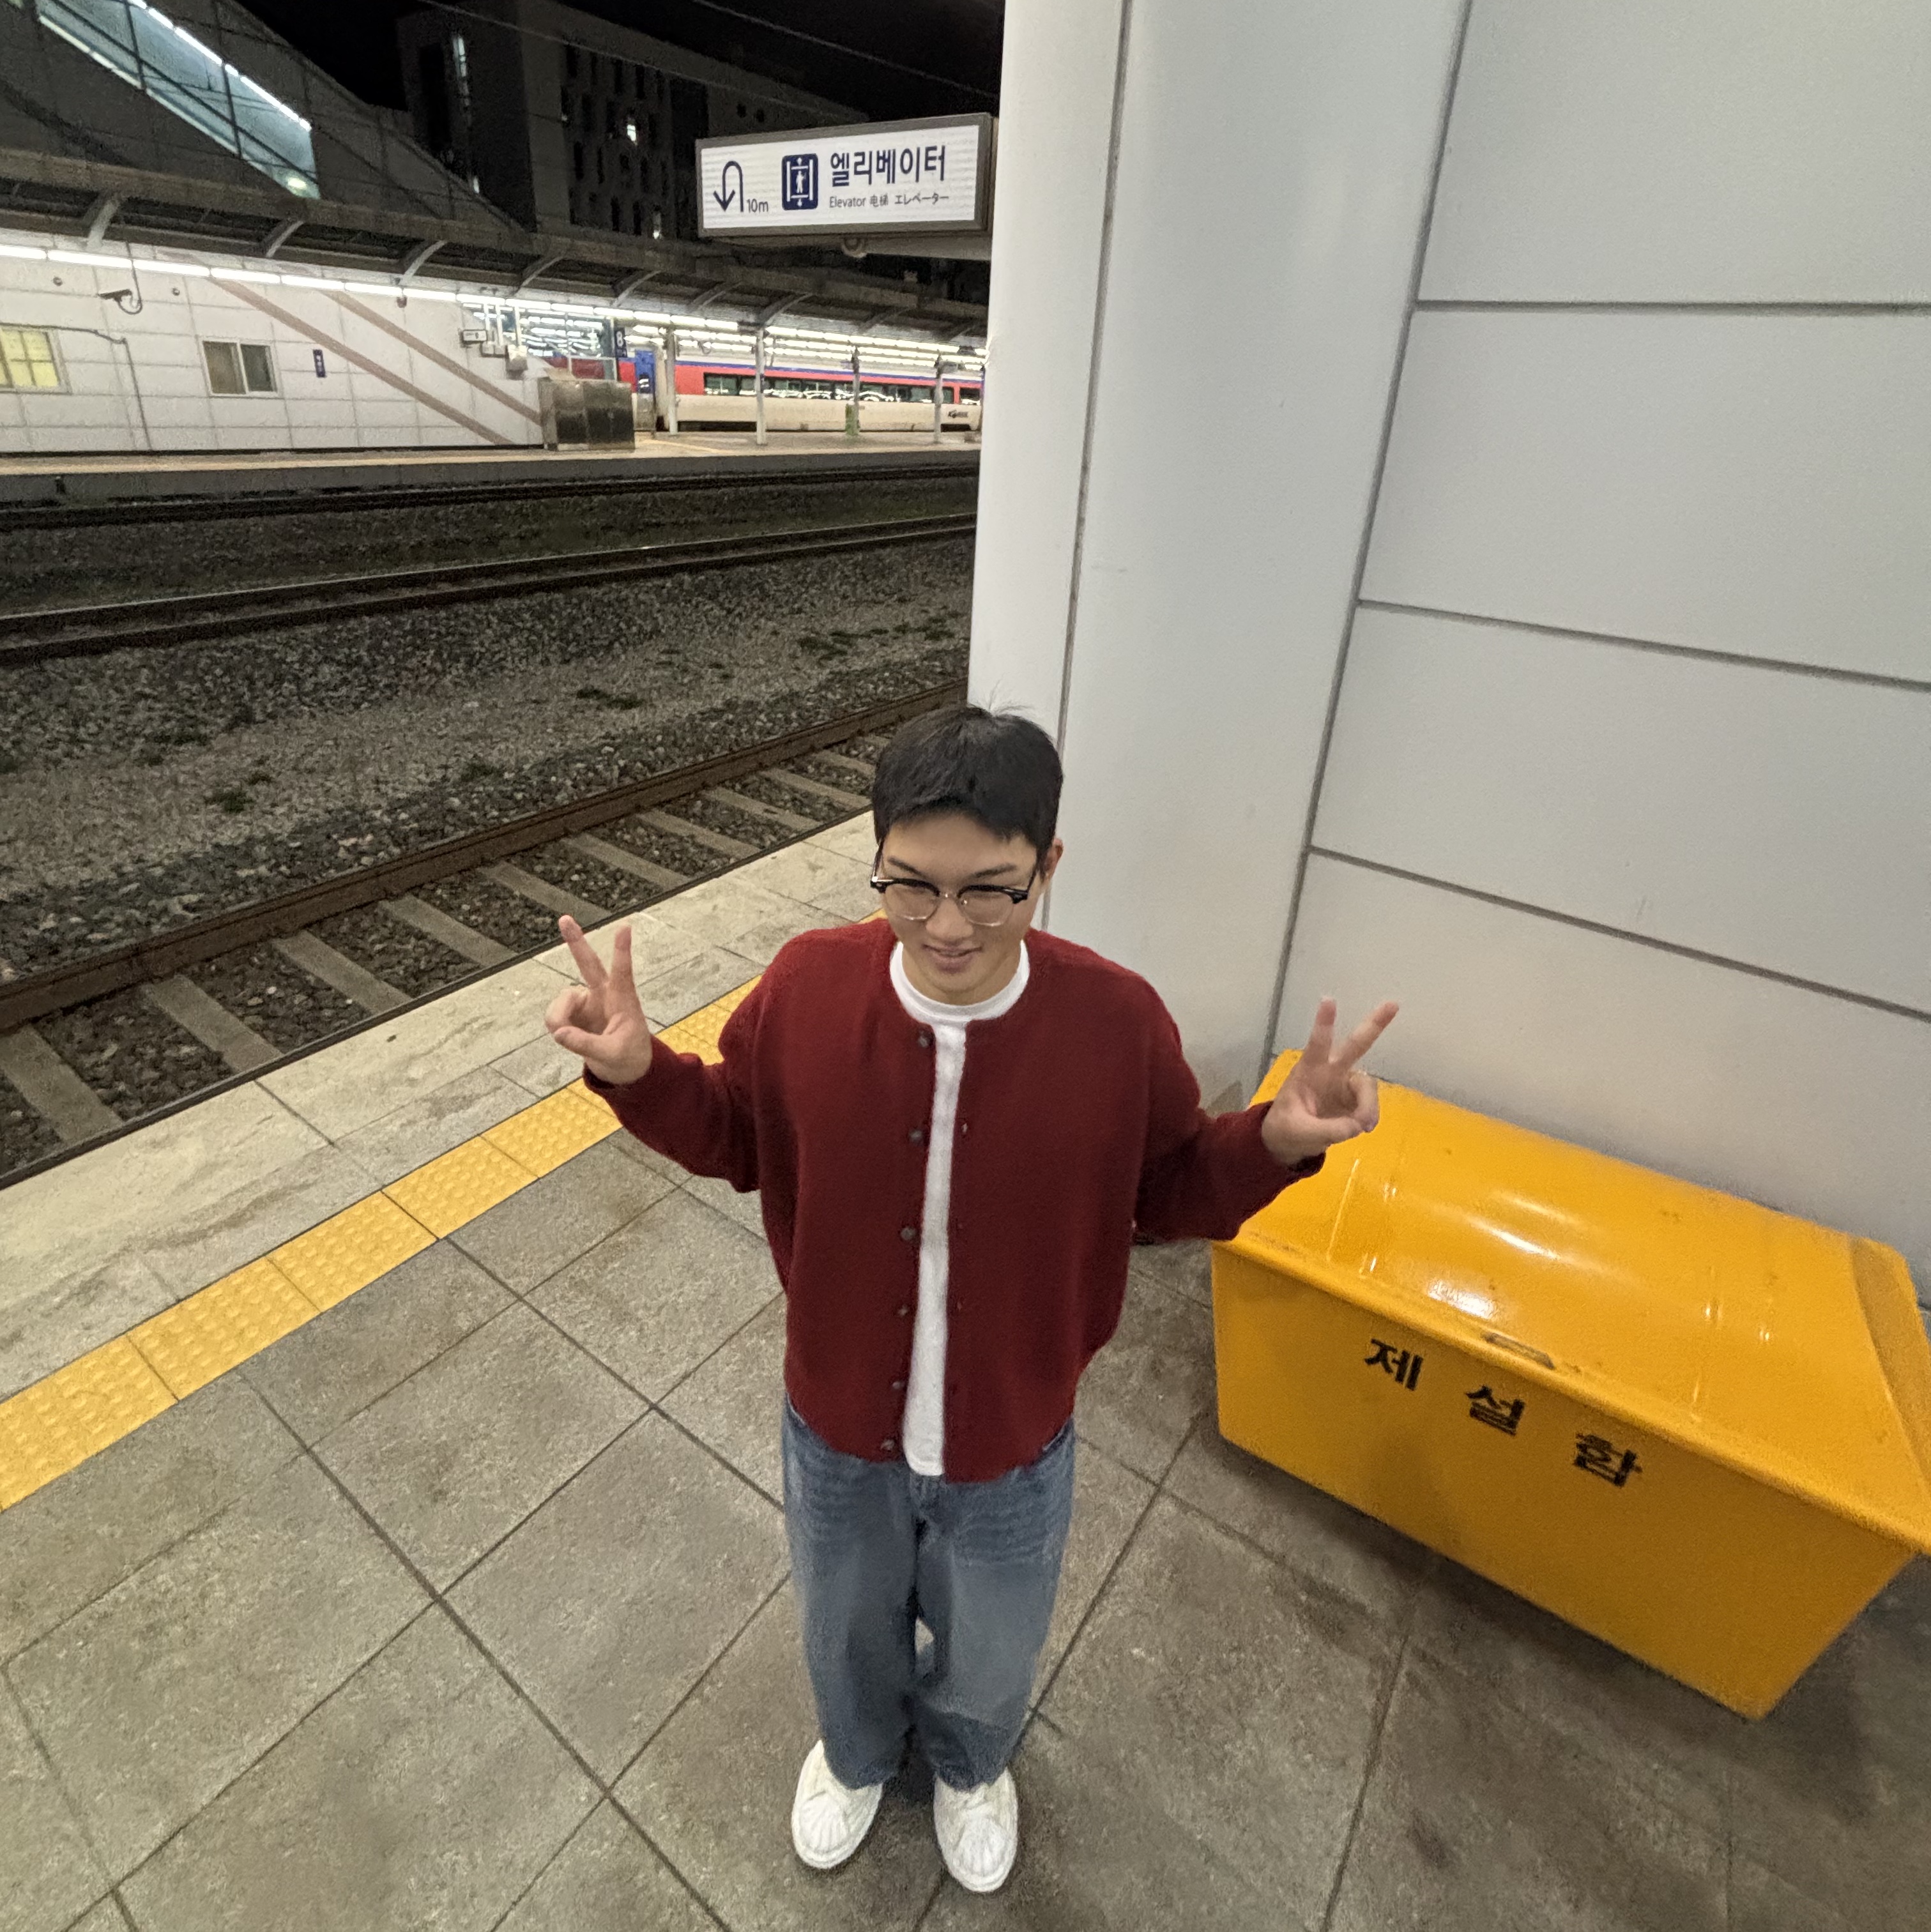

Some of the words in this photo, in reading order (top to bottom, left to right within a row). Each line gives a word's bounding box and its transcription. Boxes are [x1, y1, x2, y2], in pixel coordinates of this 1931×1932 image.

[830, 145, 945, 187] 엘리베이터
[746, 198, 769, 213] 10m
[829, 195, 866, 208] Elevator
[616, 331, 624, 347] 8
